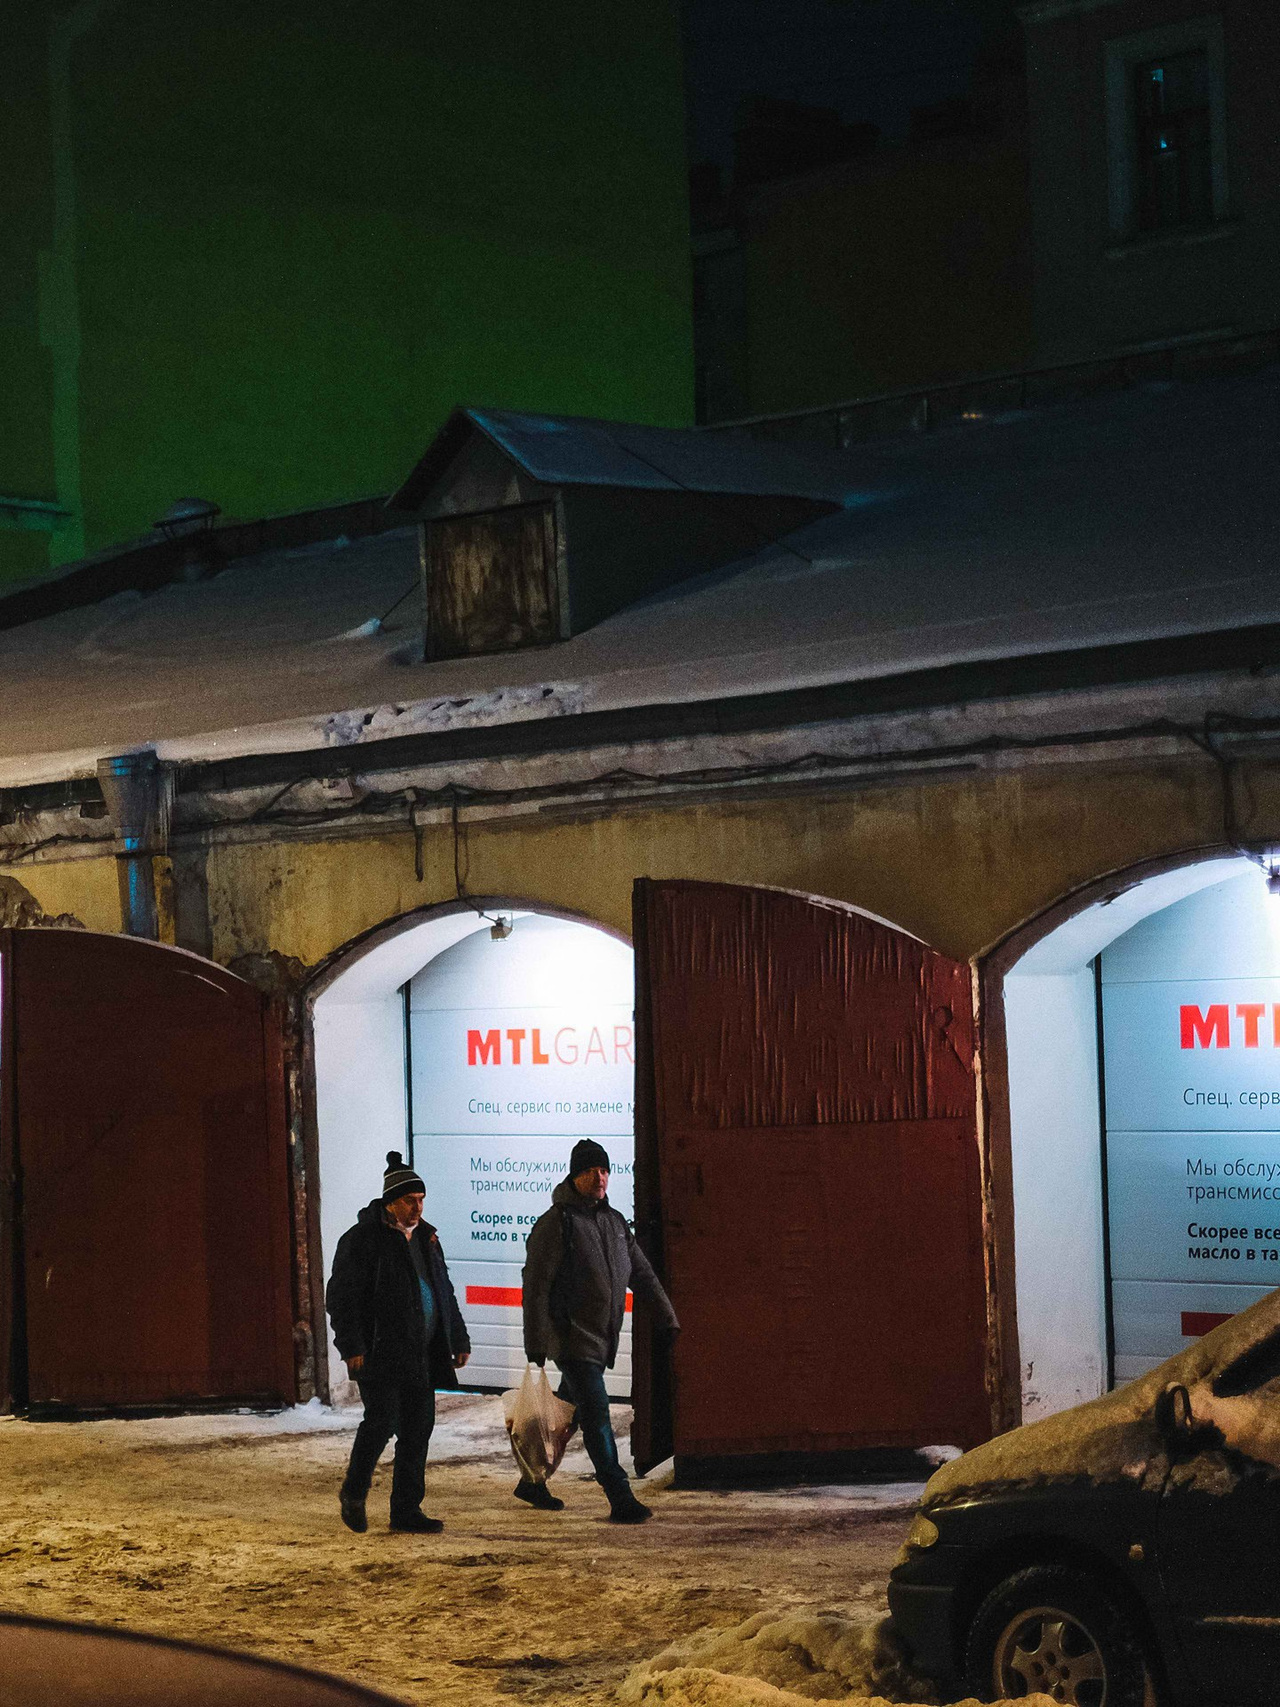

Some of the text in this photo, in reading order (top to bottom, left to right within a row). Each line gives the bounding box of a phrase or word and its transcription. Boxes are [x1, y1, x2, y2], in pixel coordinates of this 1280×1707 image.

[468, 1098, 502, 1115] Спец.
[507, 1101, 551, 1117] сервис
[555, 1101, 571, 1113] по
[575, 1101, 623, 1113] замене
[1183, 1088, 1233, 1109] Спец.
[470, 1157, 491, 1172] Мы
[496, 1157, 567, 1176] обслужили
[1186, 1158, 1217, 1176] Мы
[470, 1178, 552, 1195] трансмиссий
[470, 1210, 540, 1227] Скорее все
[471, 1232, 507, 1242] масло
[511, 1232, 518, 1242] в
[1187, 1222, 1248, 1243] Скорее
[1188, 1247, 1240, 1260] масло
[1246, 1249, 1256, 1260] в
